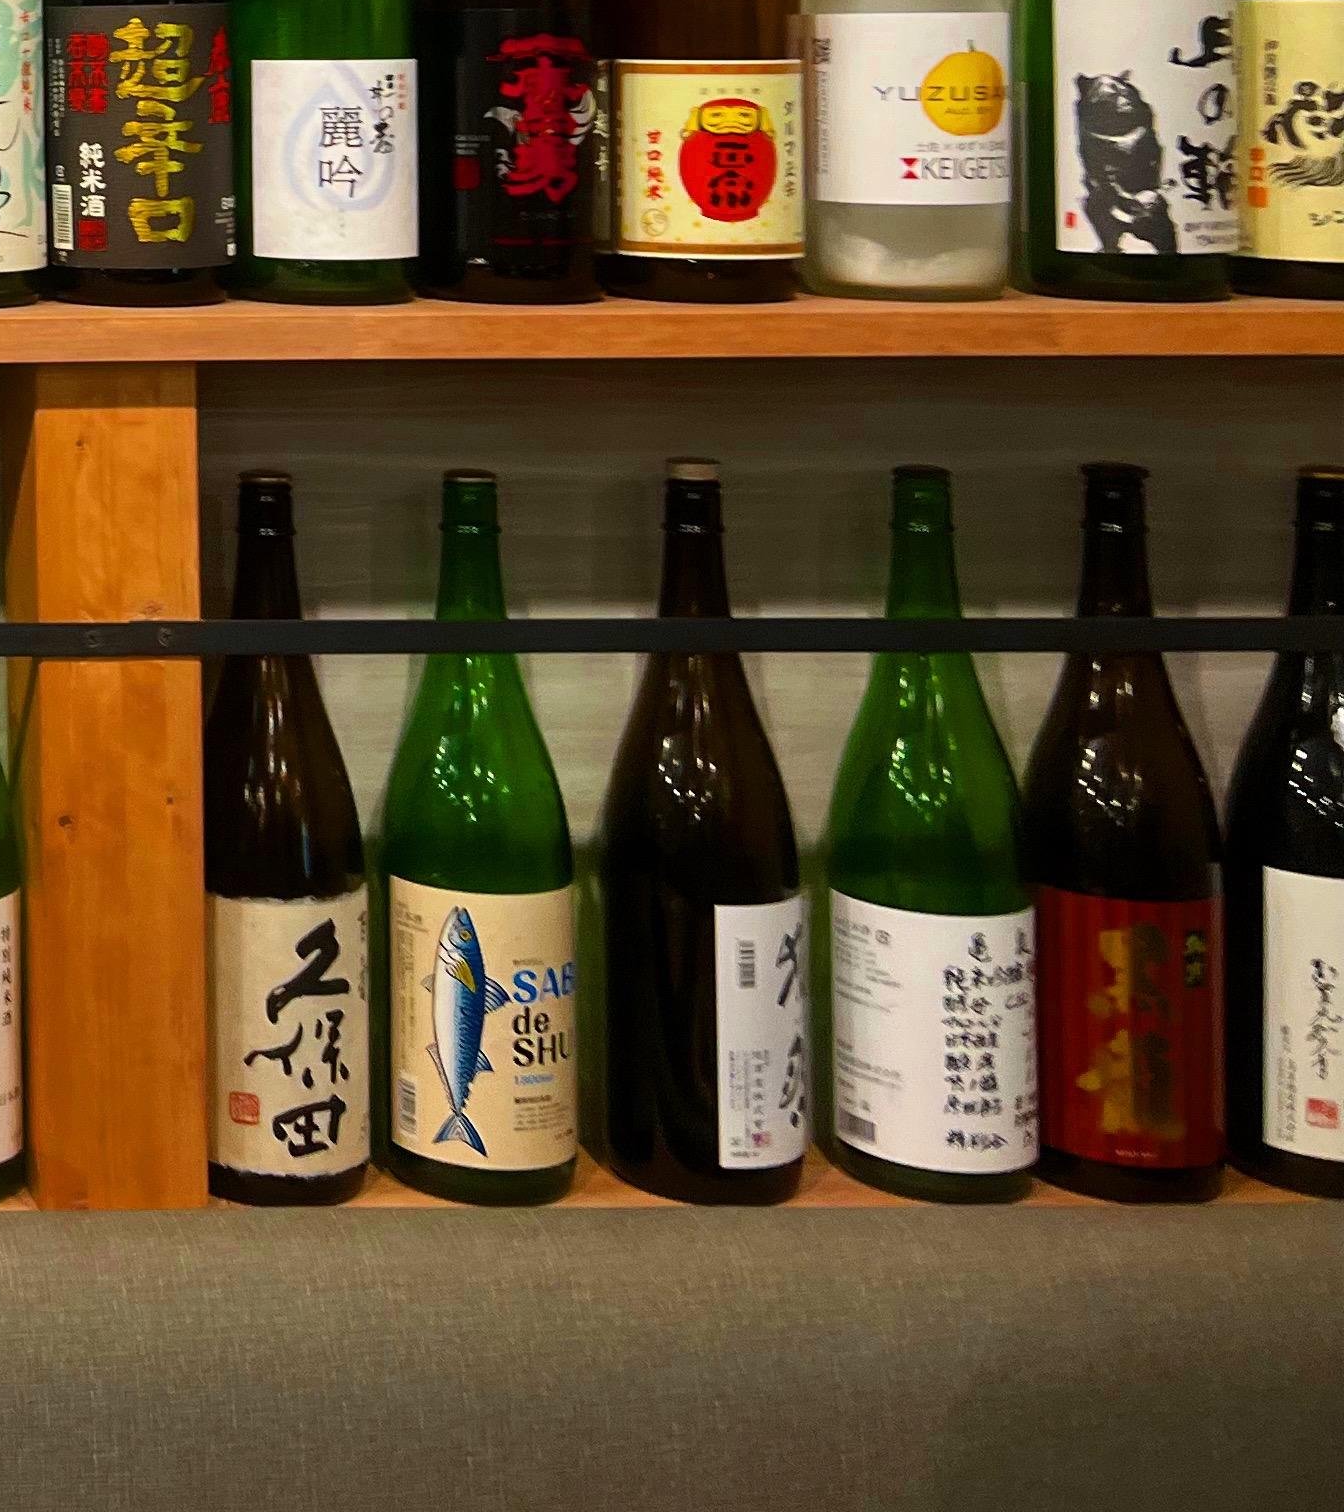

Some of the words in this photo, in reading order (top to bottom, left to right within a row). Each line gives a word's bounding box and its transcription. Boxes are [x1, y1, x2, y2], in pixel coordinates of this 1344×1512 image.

[108, 17, 206, 243] 超辛口
[318, 105, 364, 199] 麗吟
[78, 142, 107, 218] 純米酒
[512, 961, 575, 1005] SAB
[512, 1005, 550, 1036] de
[243, 917, 350, 1159] 久保田
[512, 1034, 570, 1068] SHU
